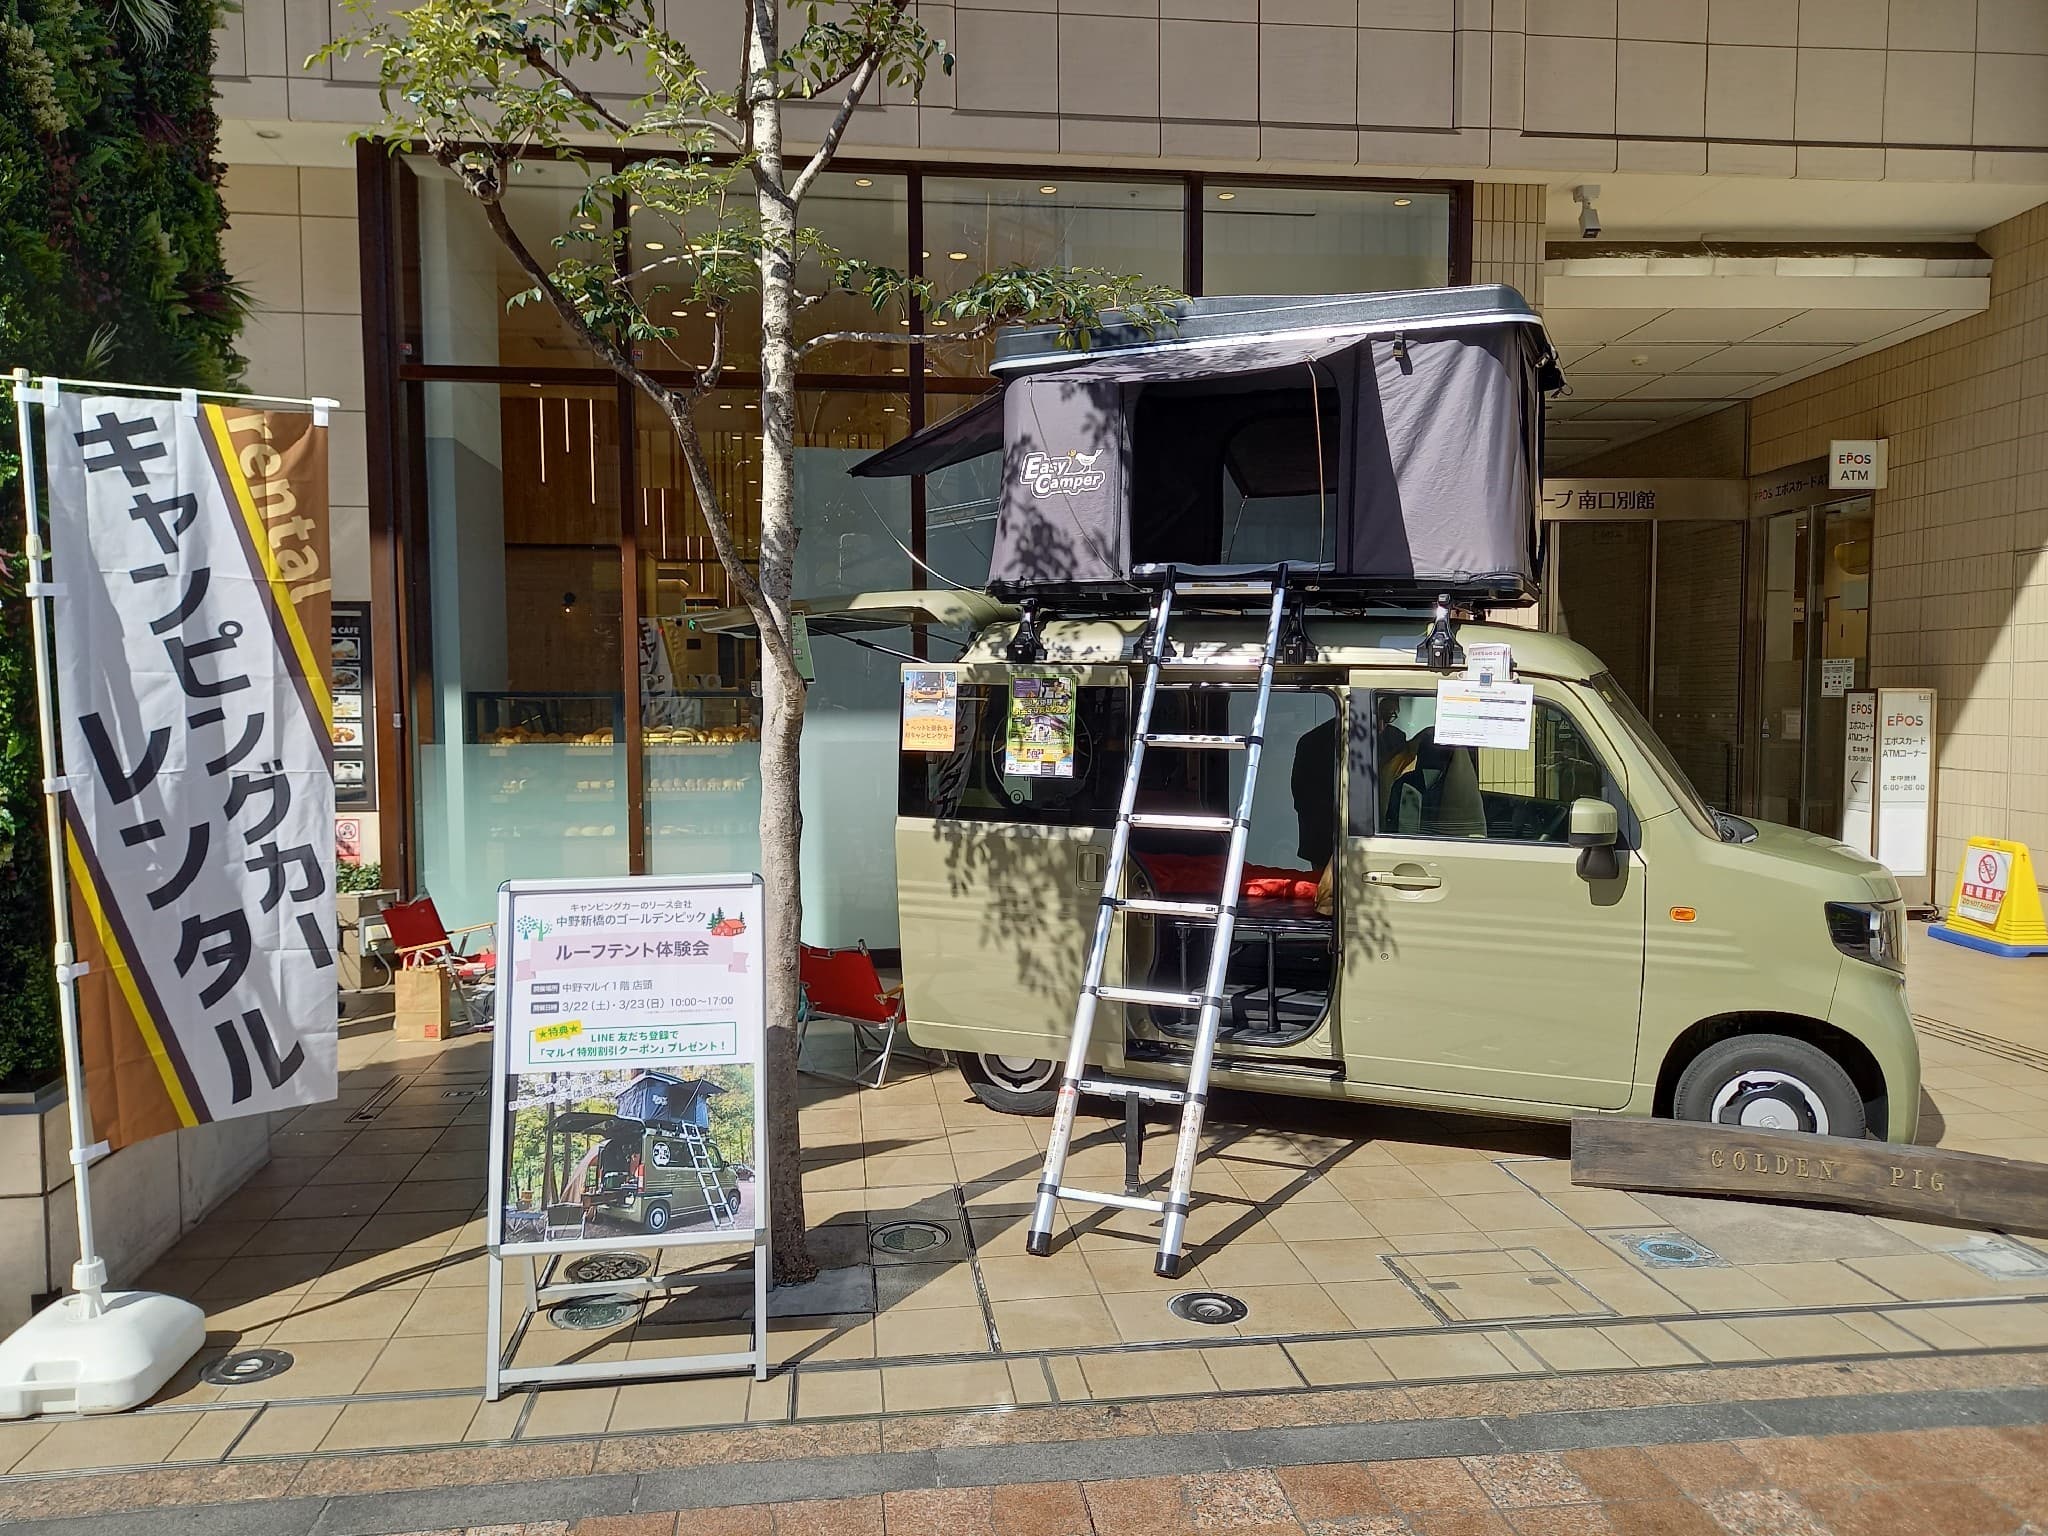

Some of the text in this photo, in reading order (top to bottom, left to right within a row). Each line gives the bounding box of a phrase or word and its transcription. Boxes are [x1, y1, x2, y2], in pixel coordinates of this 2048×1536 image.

[1838, 453, 1872, 465] EPOS
[1024, 456, 1068, 479] Easy
[1840, 470, 1869, 481] ATM
[1035, 473, 1101, 494] Camper
[1578, 489, 1656, 510] 南口別館
[226, 414, 332, 604] rental
[338, 626, 360, 634] CAFE
[74, 411, 333, 968] キャンピングカー
[1851, 702, 1873, 714] EPOS
[1849, 721, 1874, 731] エポスカード
[1887, 713, 1924, 727] EPOS
[1884, 737, 1926, 746] エポスカード
[1882, 749, 1927, 758] ATMコーナー
[78, 711, 305, 1104] レンタル
[556, 940, 709, 961] ルーフテント体験会
[632, 980, 653, 991] 店頭
[591, 1030, 679, 1043] LINE 友だち登録で
[1711, 1149, 1945, 1192] GOLDEN PIG
